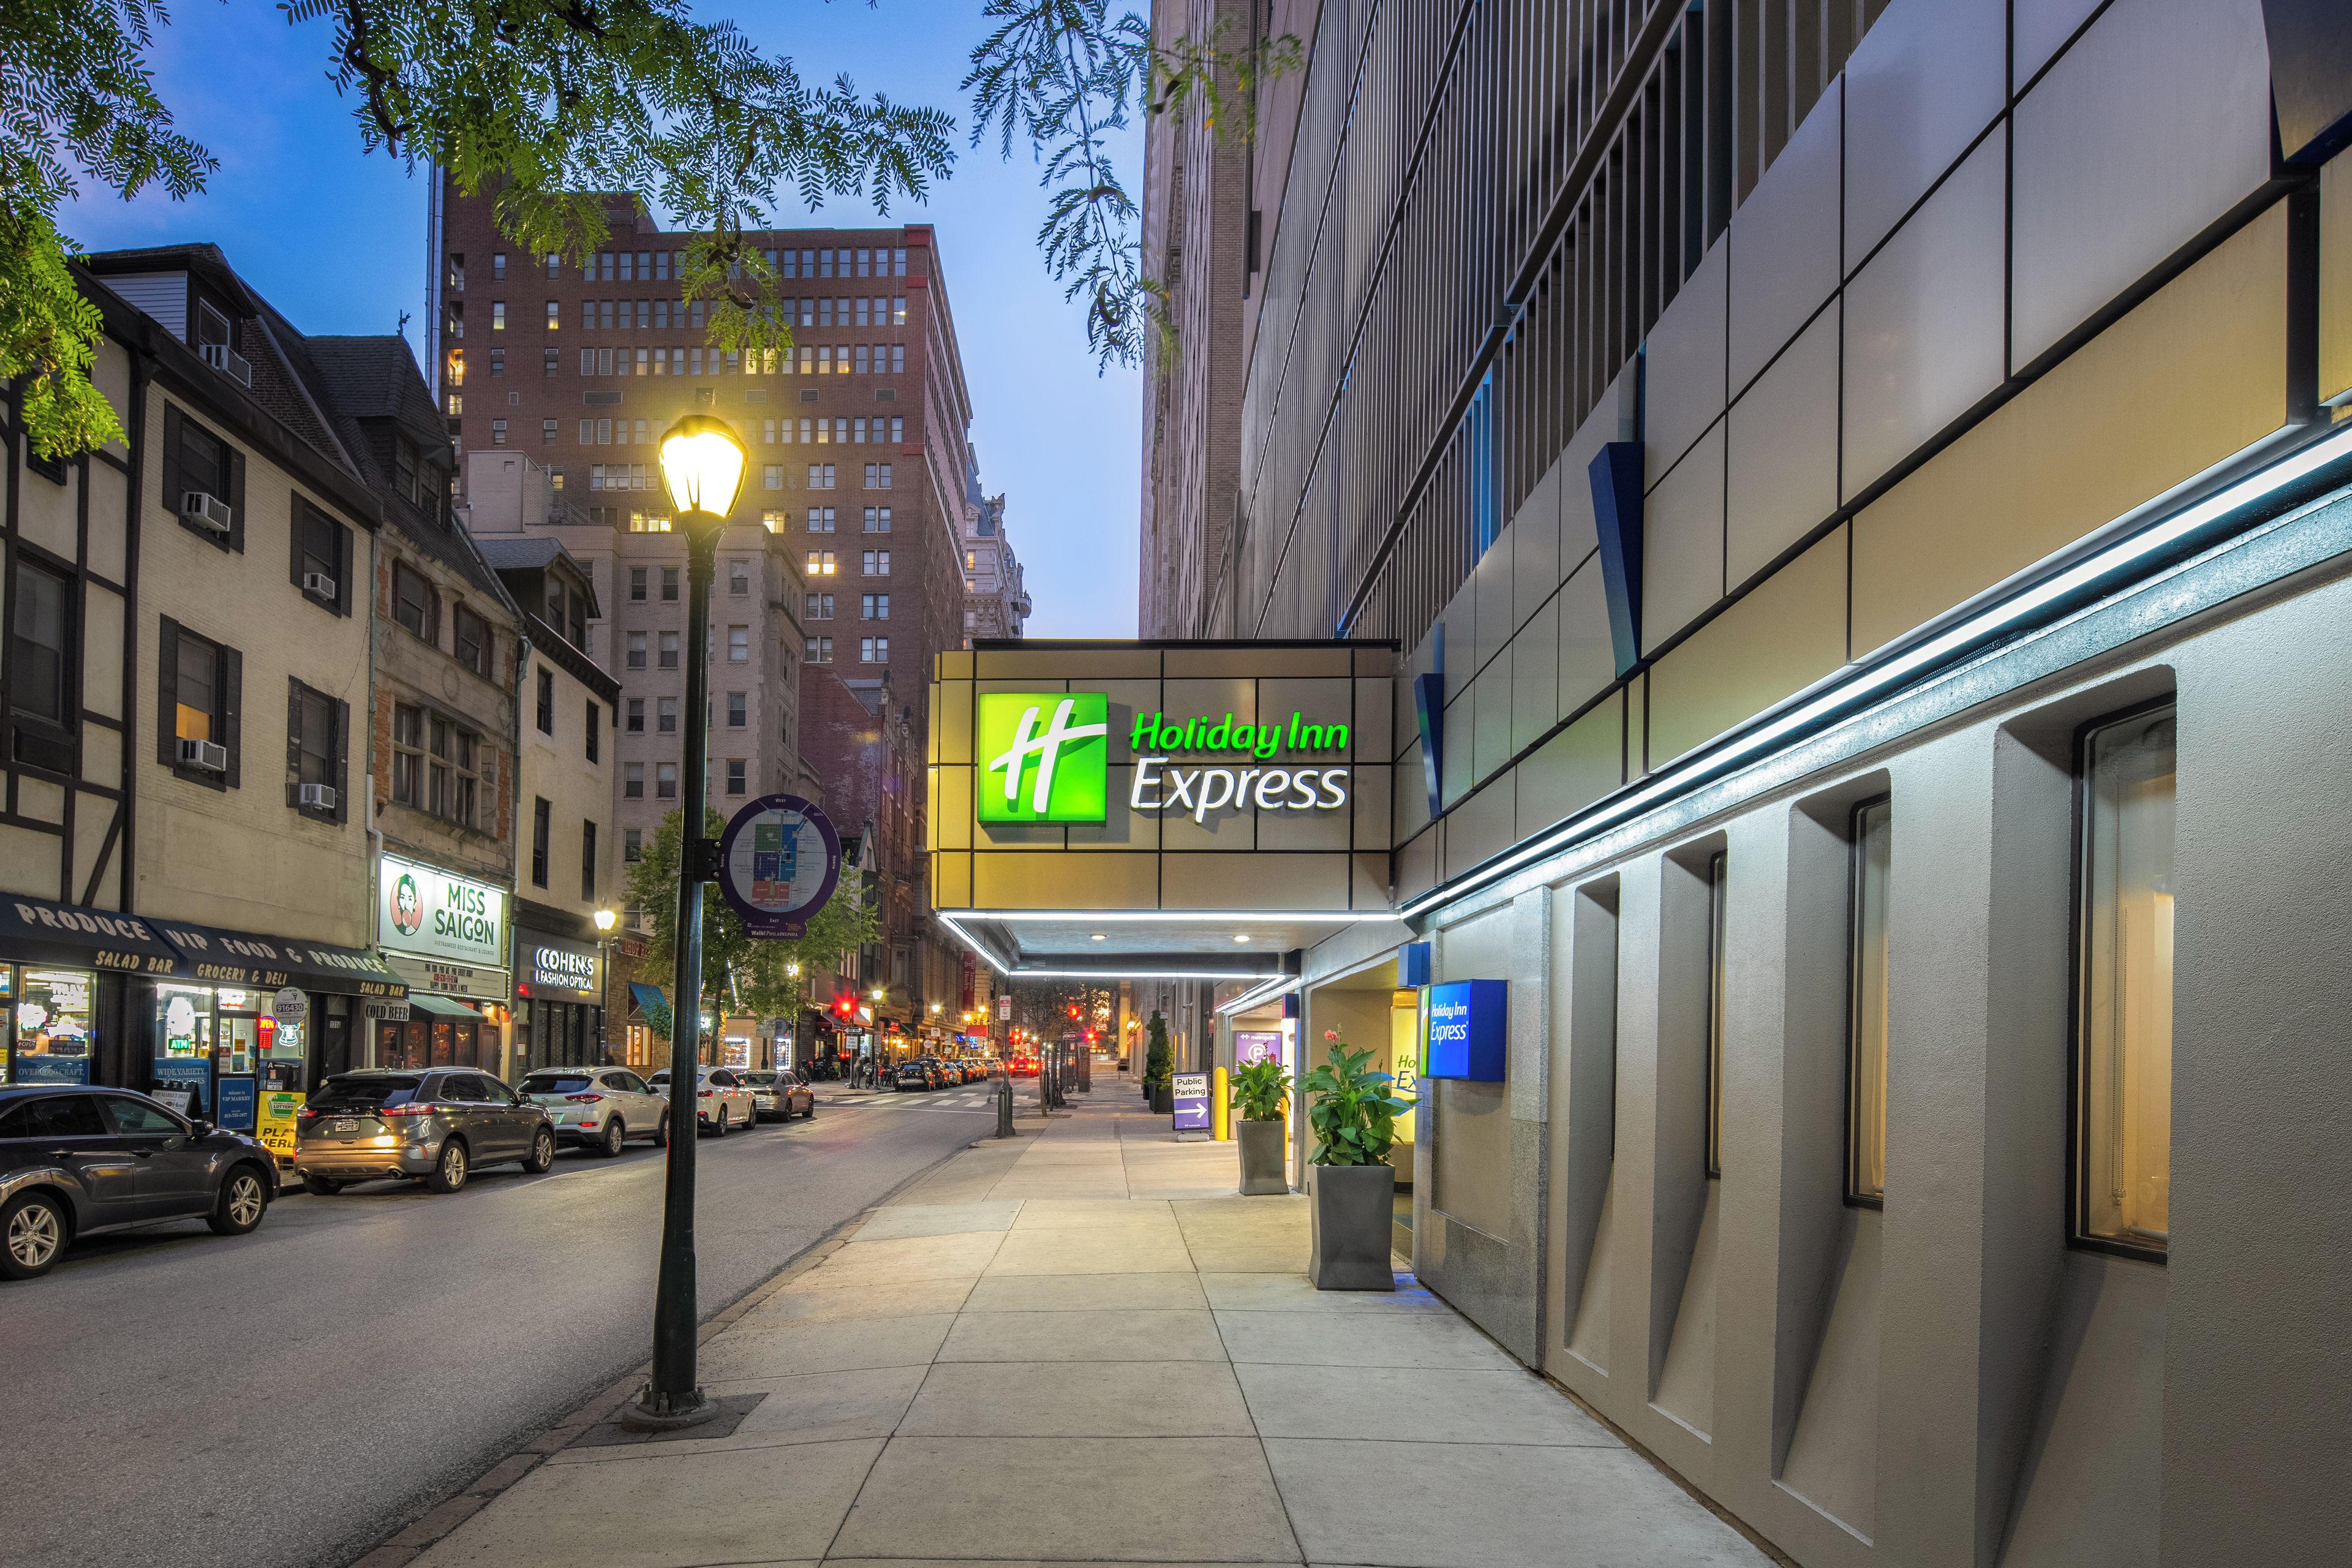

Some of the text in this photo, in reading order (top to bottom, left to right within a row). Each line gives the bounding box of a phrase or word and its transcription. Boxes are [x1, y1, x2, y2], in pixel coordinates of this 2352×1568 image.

[1129, 711, 1349, 759] Holiday Inn
[1129, 756, 1349, 826] Express
[448, 883, 485, 916] MISS
[14, 903, 151, 941] PRODUCE
[435, 909, 494, 946] SAIGON
[165, 929, 388, 974] VIP FOOD & PRODUCE
[434, 940, 456, 949] VIETNAMESE
[457, 944, 478, 953] RESTAURANT
[96, 951, 173, 973] SALAD BAR
[540, 949, 594, 976] COHEN'S
[197, 963, 287, 986] GROCERY & DELI
[540, 971, 594, 990] FASHION OPTICAL
[360, 982, 404, 997] SALAD BAR
[277, 1004, 303, 1012] 916430
[366, 1005, 409, 1020] COLD BEER
[1431, 1001, 1467, 1020] Holiday Inn
[1431, 1021, 1467, 1046] Express
[171, 1040, 187, 1049] ATM
[1253, 1047, 1263, 1059] P
[1398, 1055, 1417, 1068] Ho
[59, 1068, 85, 1077] CRAFT,
[1177, 1077, 1202, 1086] Public
[1396, 1071, 1417, 1088] Ex
[1175, 1088, 1205, 1096] Parking
